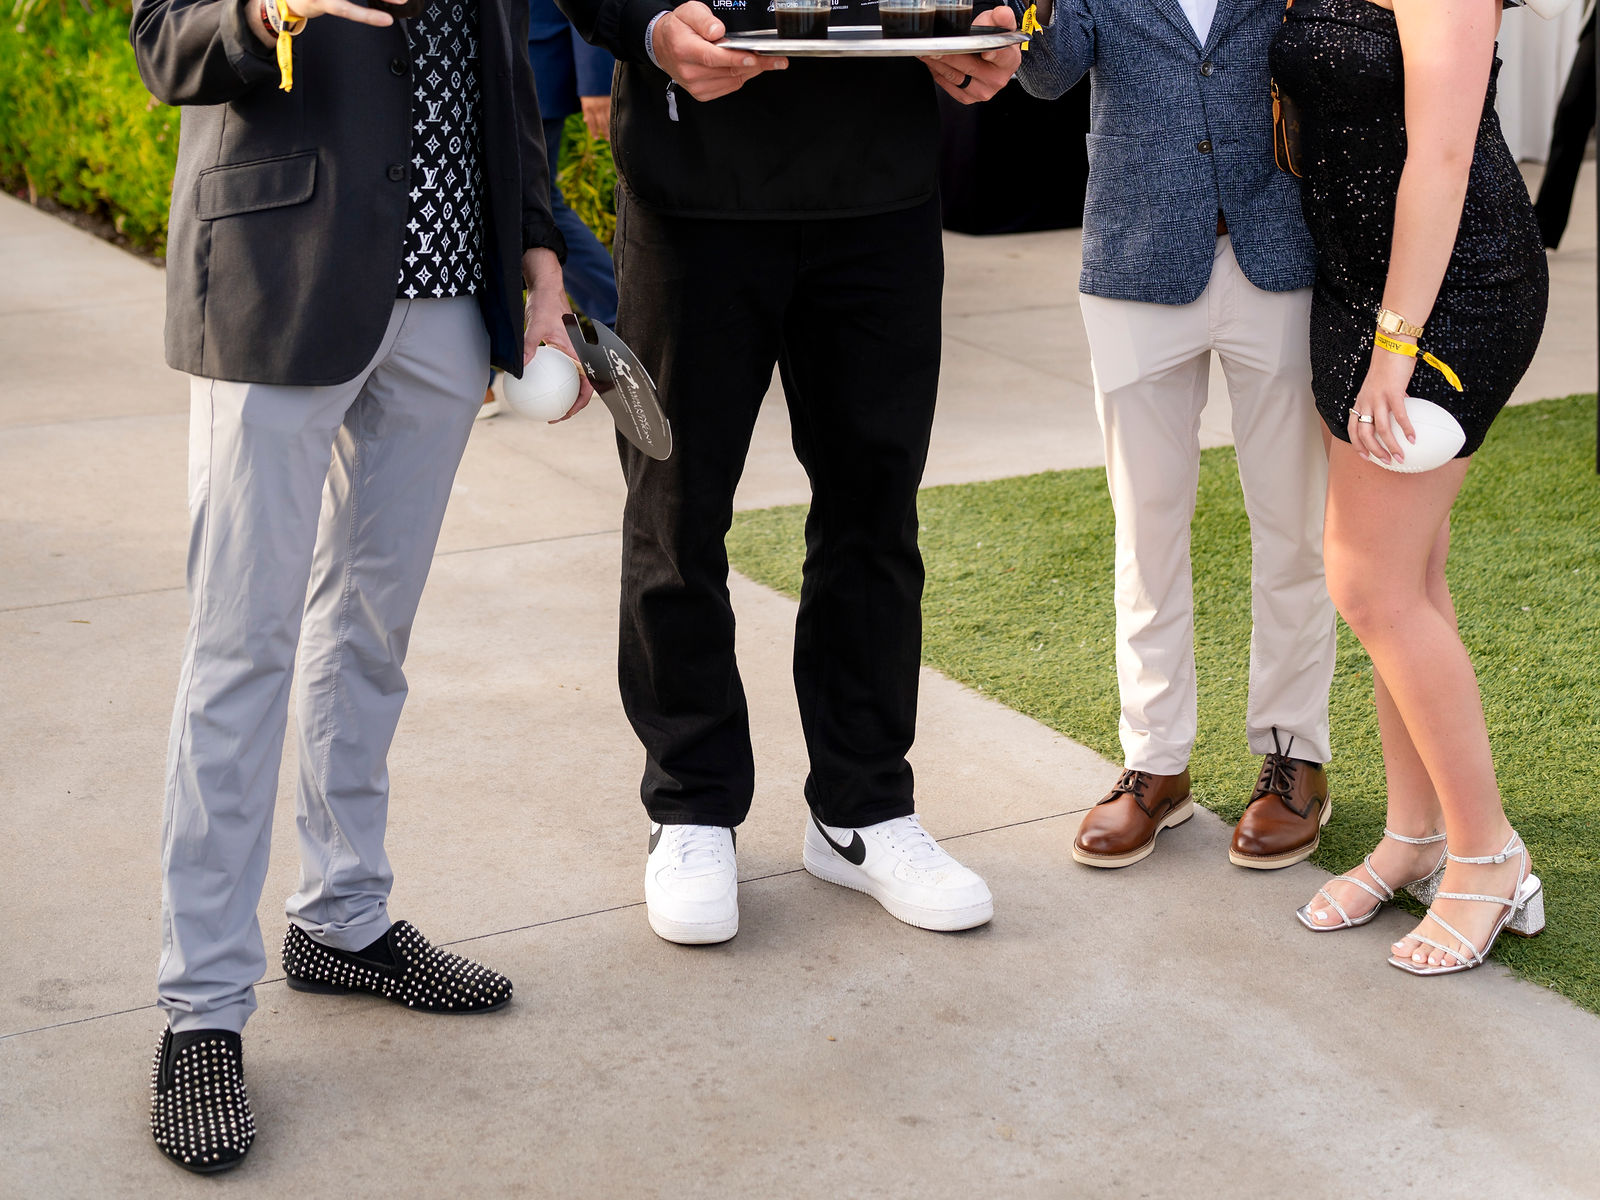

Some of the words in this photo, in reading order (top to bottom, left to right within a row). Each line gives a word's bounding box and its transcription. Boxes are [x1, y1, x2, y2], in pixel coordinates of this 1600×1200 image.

[426, 34, 442, 56] LV
[425, 100, 442, 122] LV
[421, 167, 439, 189] LV
[417, 232, 435, 254] LV
